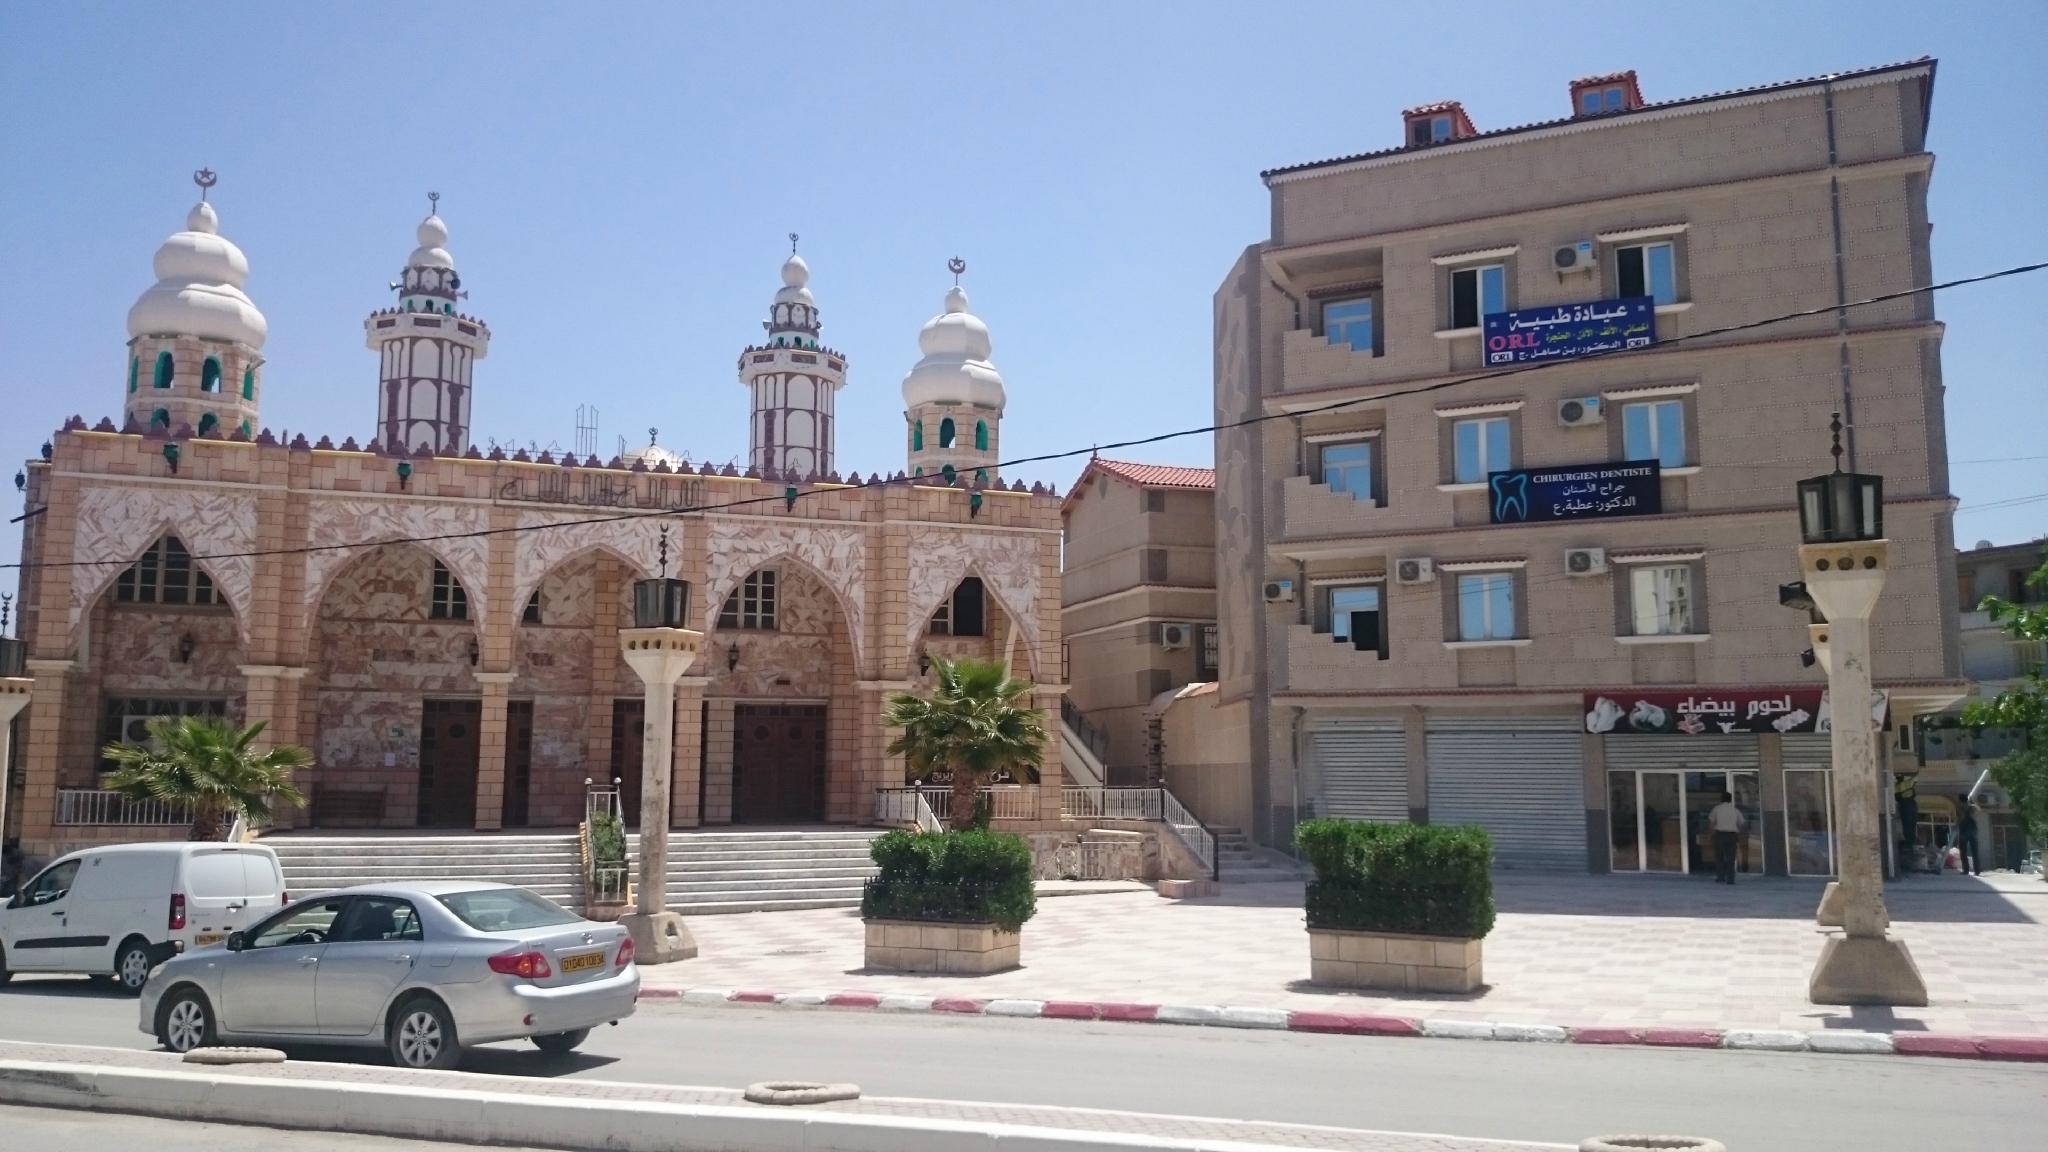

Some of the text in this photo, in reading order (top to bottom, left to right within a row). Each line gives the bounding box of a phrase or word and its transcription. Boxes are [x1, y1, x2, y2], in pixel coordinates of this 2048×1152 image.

[1509, 305, 1628, 331] عيادة طبية
[1489, 332, 1540, 351] ORL
[1492, 353, 1511, 362] ORL
[1532, 467, 1652, 483] CHIRURGIEN DENTISTE
[1562, 482, 1625, 496] جراح الأسنان
[1676, 694, 1791, 720] لحوم بيضاء
